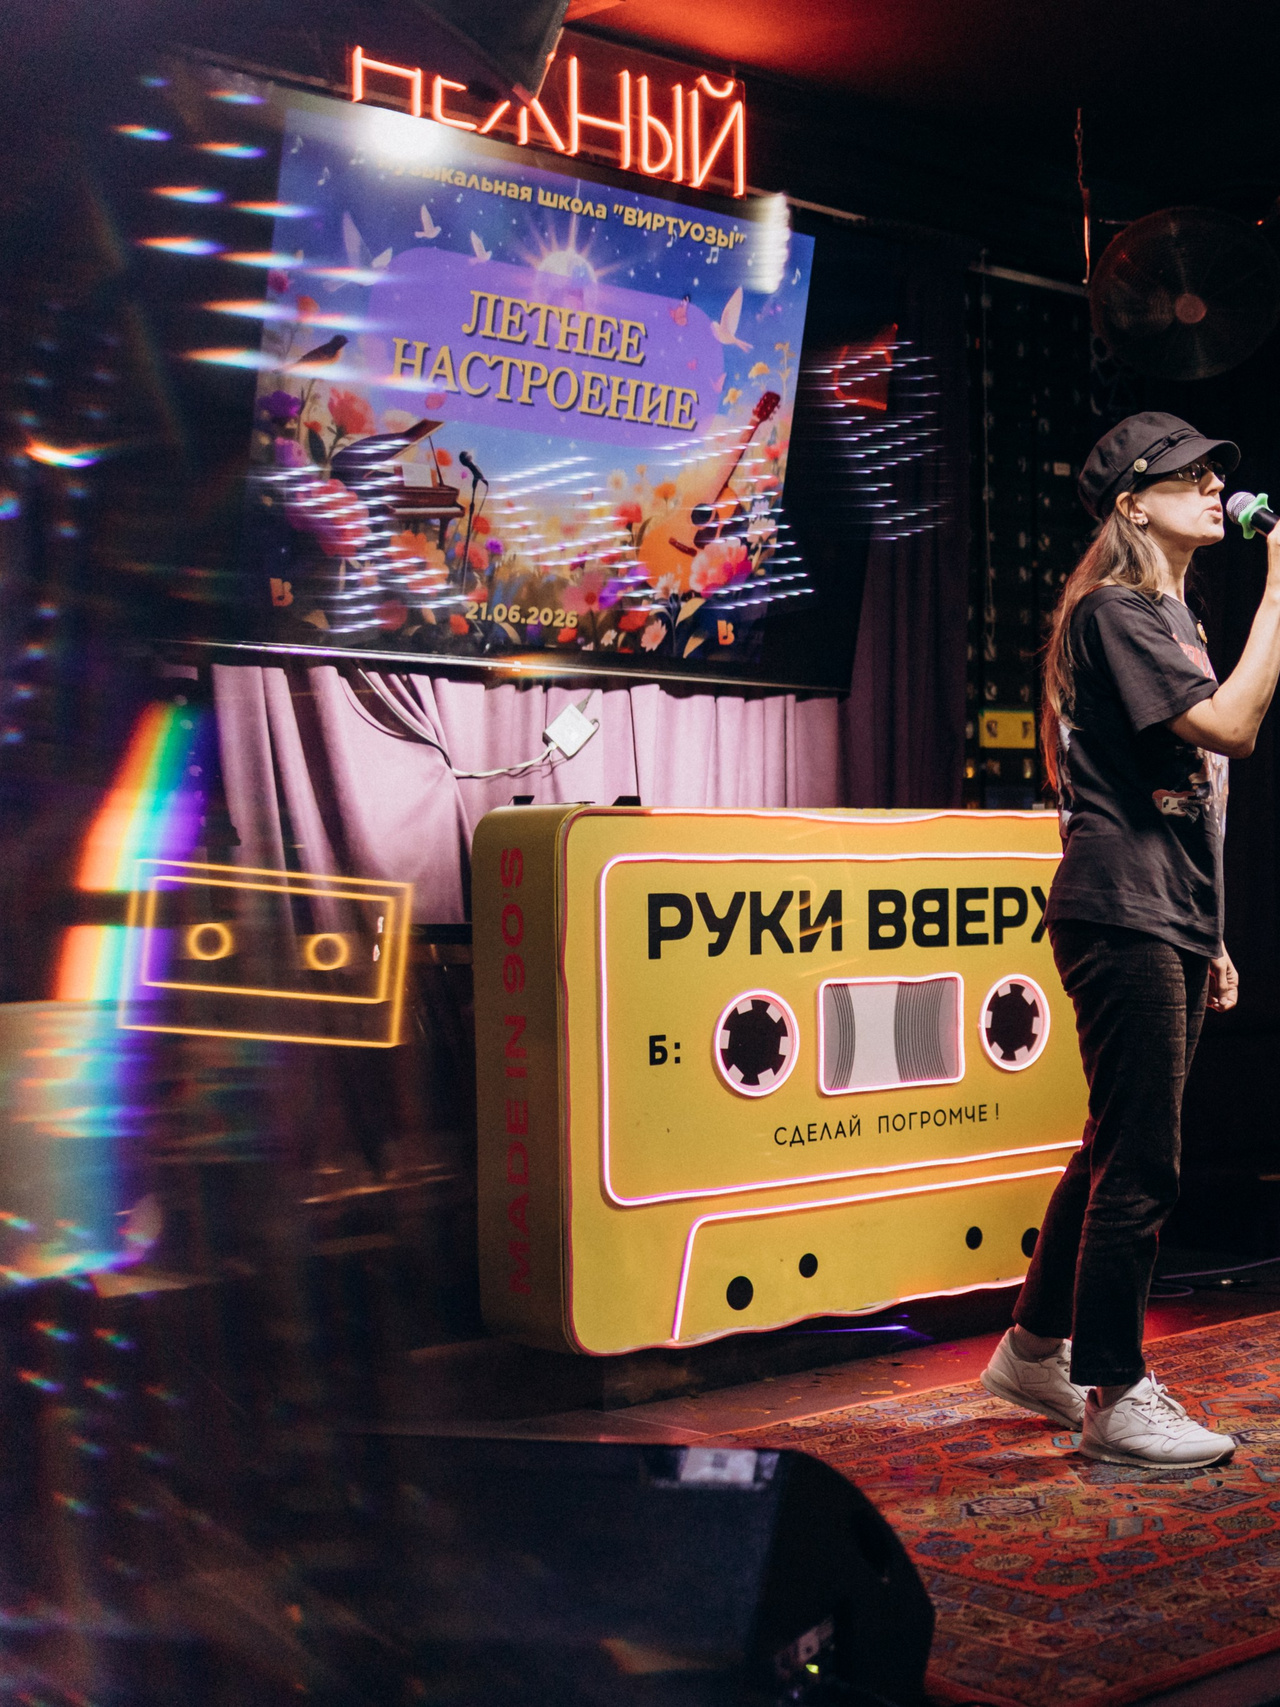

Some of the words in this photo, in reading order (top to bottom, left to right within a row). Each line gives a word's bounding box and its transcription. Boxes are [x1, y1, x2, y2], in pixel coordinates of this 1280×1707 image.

[377, 161, 533, 203] зыкальная
[537, 186, 608, 219] школа
[613, 206, 747, 250] "ВИРТУОЗЫ"
[462, 289, 648, 366] ЛЕТНЕЕ
[390, 336, 700, 432] НАСТРОЕНИЕ
[465, 602, 579, 628] 21.06.2026
[500, 847, 526, 994] 90'S
[647, 890, 843, 959] РУКИ
[504, 1014, 529, 1079] IN
[648, 1034, 682, 1066] Б:
[773, 1114, 862, 1147] СДЕЛАЙ
[507, 1099, 533, 1296] MADE
